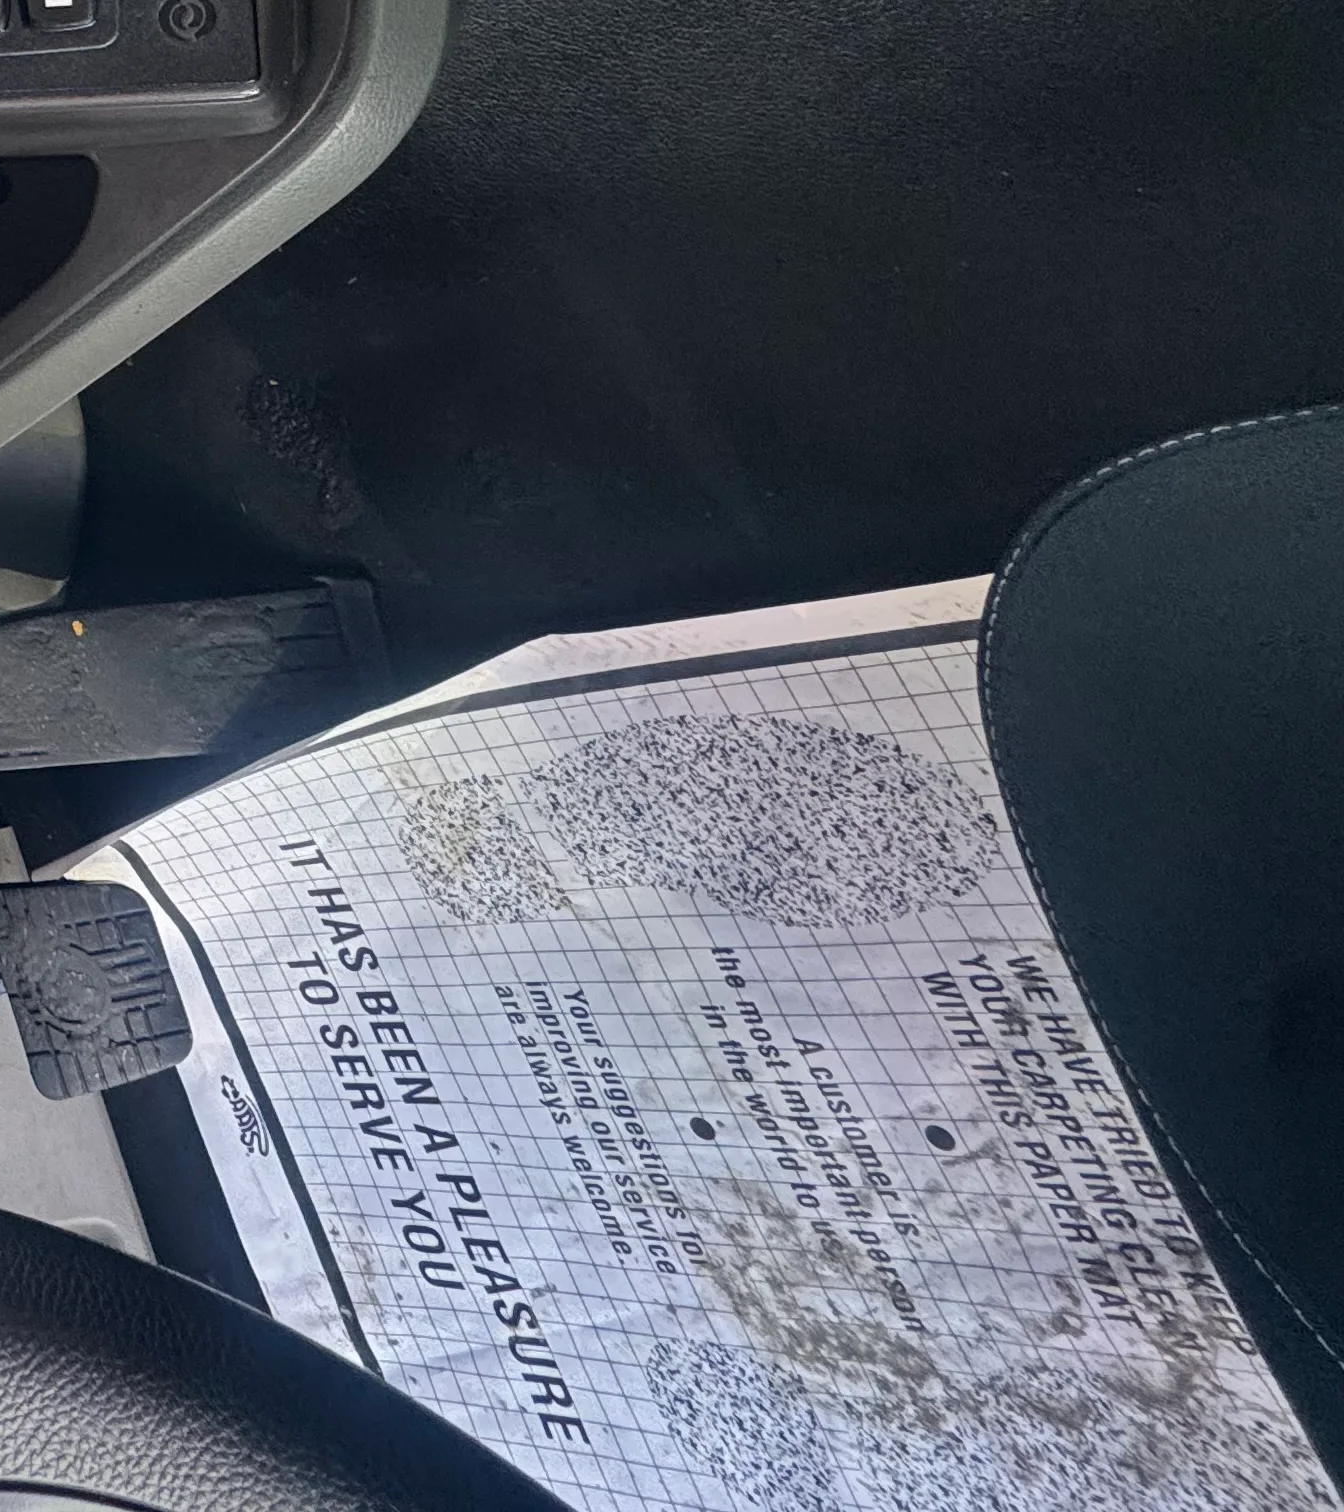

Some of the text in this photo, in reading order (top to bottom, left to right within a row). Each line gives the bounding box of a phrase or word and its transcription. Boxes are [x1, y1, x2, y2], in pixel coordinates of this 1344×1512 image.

[279, 839, 590, 1446] IT HAS BEEN A PLEASURE
[286, 950, 464, 1290] TO SERVE YOU
[494, 985, 635, 1267] are always welcome.
[525, 982, 679, 1274] improving our service
[562, 990, 708, 1267] Your suggestions for
[699, 1004, 821, 1208] in the world to
[711, 947, 926, 1333] the most important person
[793, 1037, 921, 1238] A customer is
[921, 970, 1143, 1330] WITH THIS PAPER MAT
[958, 954, 1030, 1037] YOUR
[1012, 1048, 1138, 1229] CARPETING
[1006, 956, 1058, 1003] WE
[1036, 1014, 1110, 1095] HAVE
[1092, 1108, 1171, 1200] TRIED
[1153, 1215, 1201, 1257] TO
